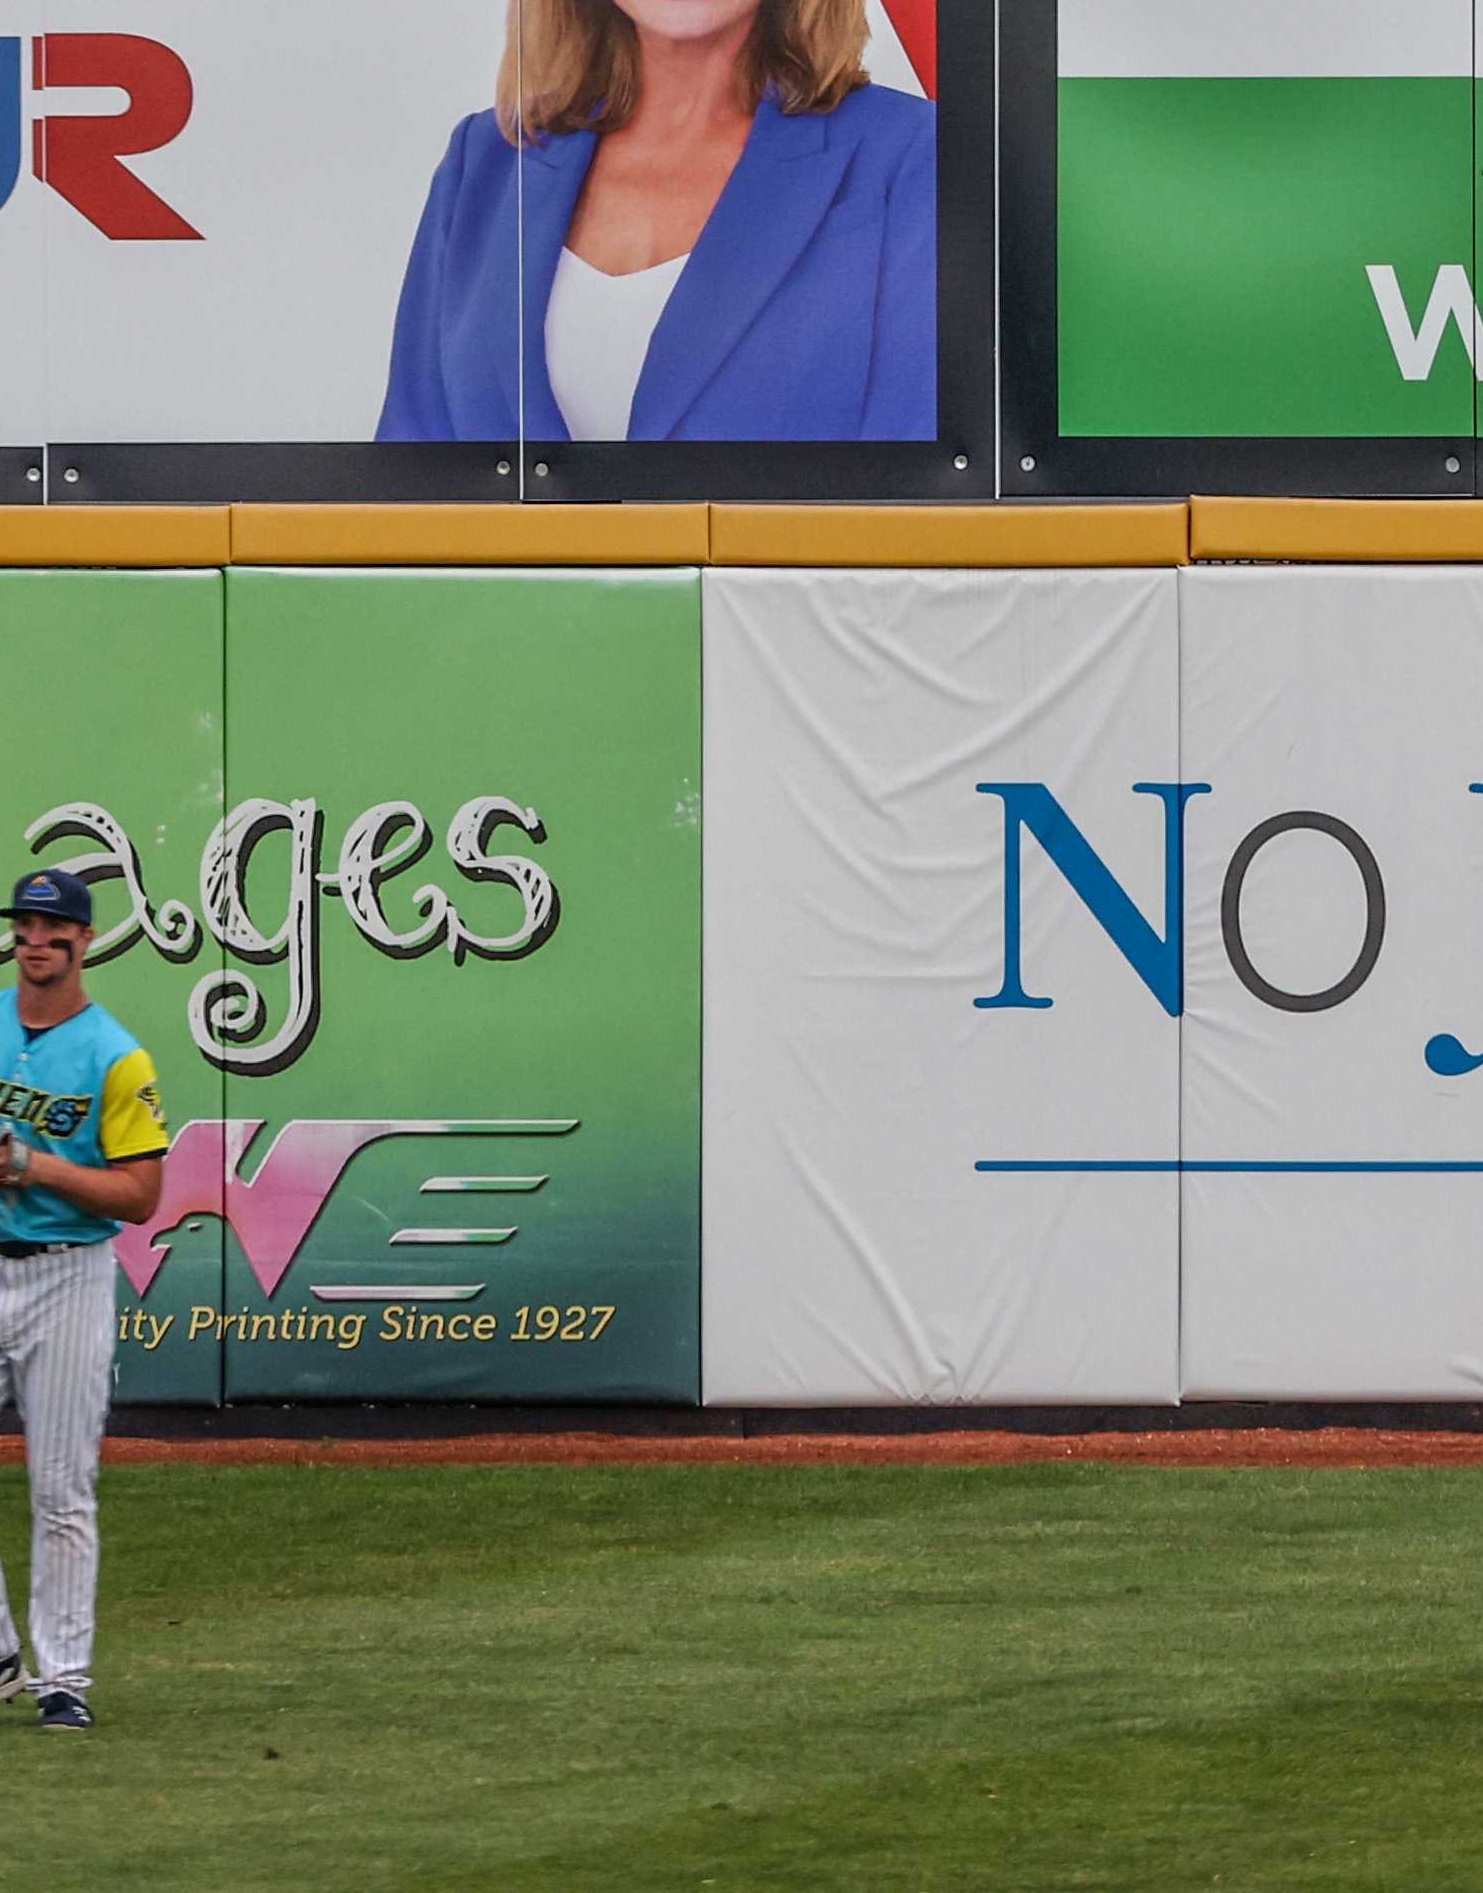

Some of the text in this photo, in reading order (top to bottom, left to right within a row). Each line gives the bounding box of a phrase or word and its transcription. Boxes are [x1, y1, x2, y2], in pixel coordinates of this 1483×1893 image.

[973, 783, 1385, 1017] NO
[189, 1306, 366, 1348] Printing
[380, 1306, 495, 1339] Since
[511, 1306, 615, 1339] 1927
